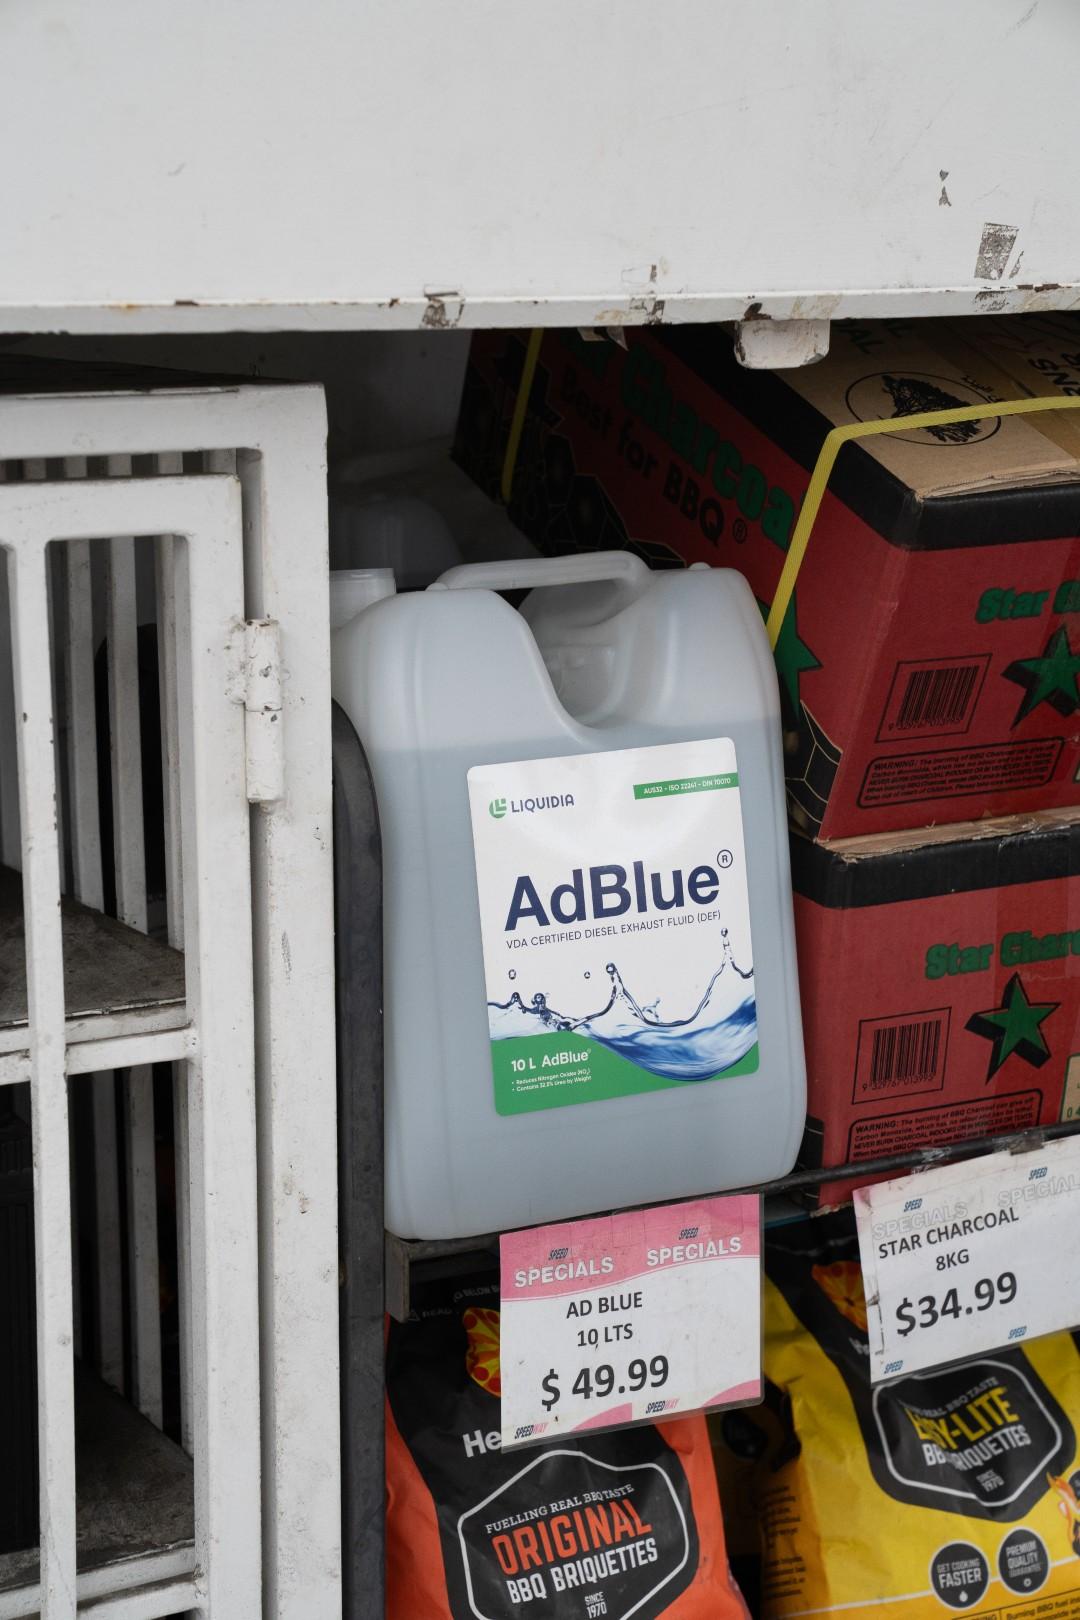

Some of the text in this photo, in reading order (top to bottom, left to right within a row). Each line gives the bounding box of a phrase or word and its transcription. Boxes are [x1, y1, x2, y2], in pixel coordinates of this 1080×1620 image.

[621, 342, 795, 550] Charcoa
[662, 459, 724, 547] BBQ
[977, 588, 1050, 623] Star
[510, 793, 575, 814] LIQUIDIA
[506, 910, 722, 949] VDA CERTIFIED DIESEL EXHAUST FLUID (DEF)
[926, 942, 994, 979] Star
[511, 1059, 526, 1072] 10
[529, 1058, 536, 1070] L
[855, 1121, 899, 1134] WARNING:
[872, 1173, 1080, 1240] SPECIALS SPECIAL
[904, 1166, 1048, 1212] SPEED SPEED
[878, 1207, 1020, 1259] STAR CHARCOAL
[514, 1237, 742, 1289] SPECIALS SPECIALS
[936, 1249, 970, 1271] 8KG
[566, 1292, 643, 1319] AD BLUE
[896, 1272, 1018, 1337] $34.99
[577, 1323, 633, 1347] 10 LTS
[1008, 1326, 1027, 1340] SPEED
[486, 1483, 635, 1534] FUELLING REAL BBQ TASTE
[491, 1499, 653, 1576] ORIGINAL
[506, 1537, 658, 1604] BBQ BRIQUETTES
[951, 1558, 980, 1570] COOKING
[1007, 1552, 1038, 1569] QUALITY
[938, 1568, 982, 1589] FASTER
[585, 1592, 604, 1605] SINCE
[587, 1604, 607, 1619] 1970
